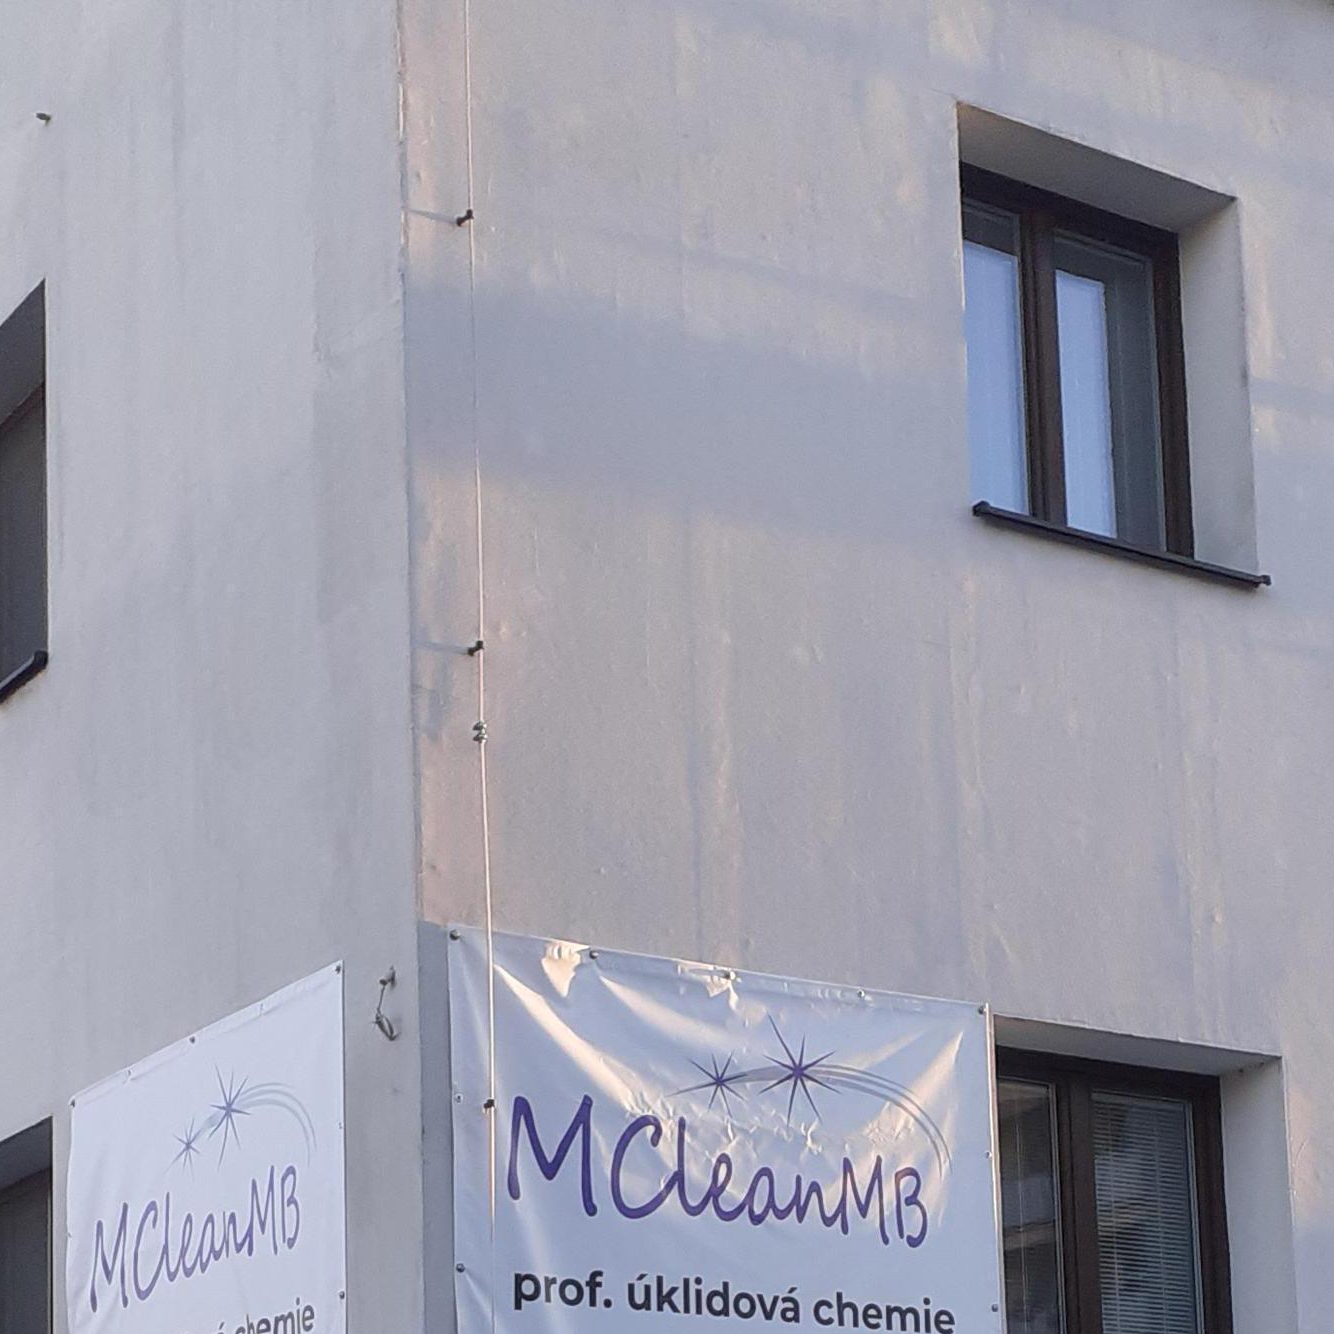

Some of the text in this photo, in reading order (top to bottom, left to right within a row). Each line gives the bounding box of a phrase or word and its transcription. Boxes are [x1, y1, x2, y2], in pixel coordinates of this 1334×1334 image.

[90, 1164, 301, 1313] MCleanMB
[507, 1094, 930, 1249] MCleanMB
[512, 1270, 613, 1311] prof.
[626, 1274, 802, 1325] úklidová
